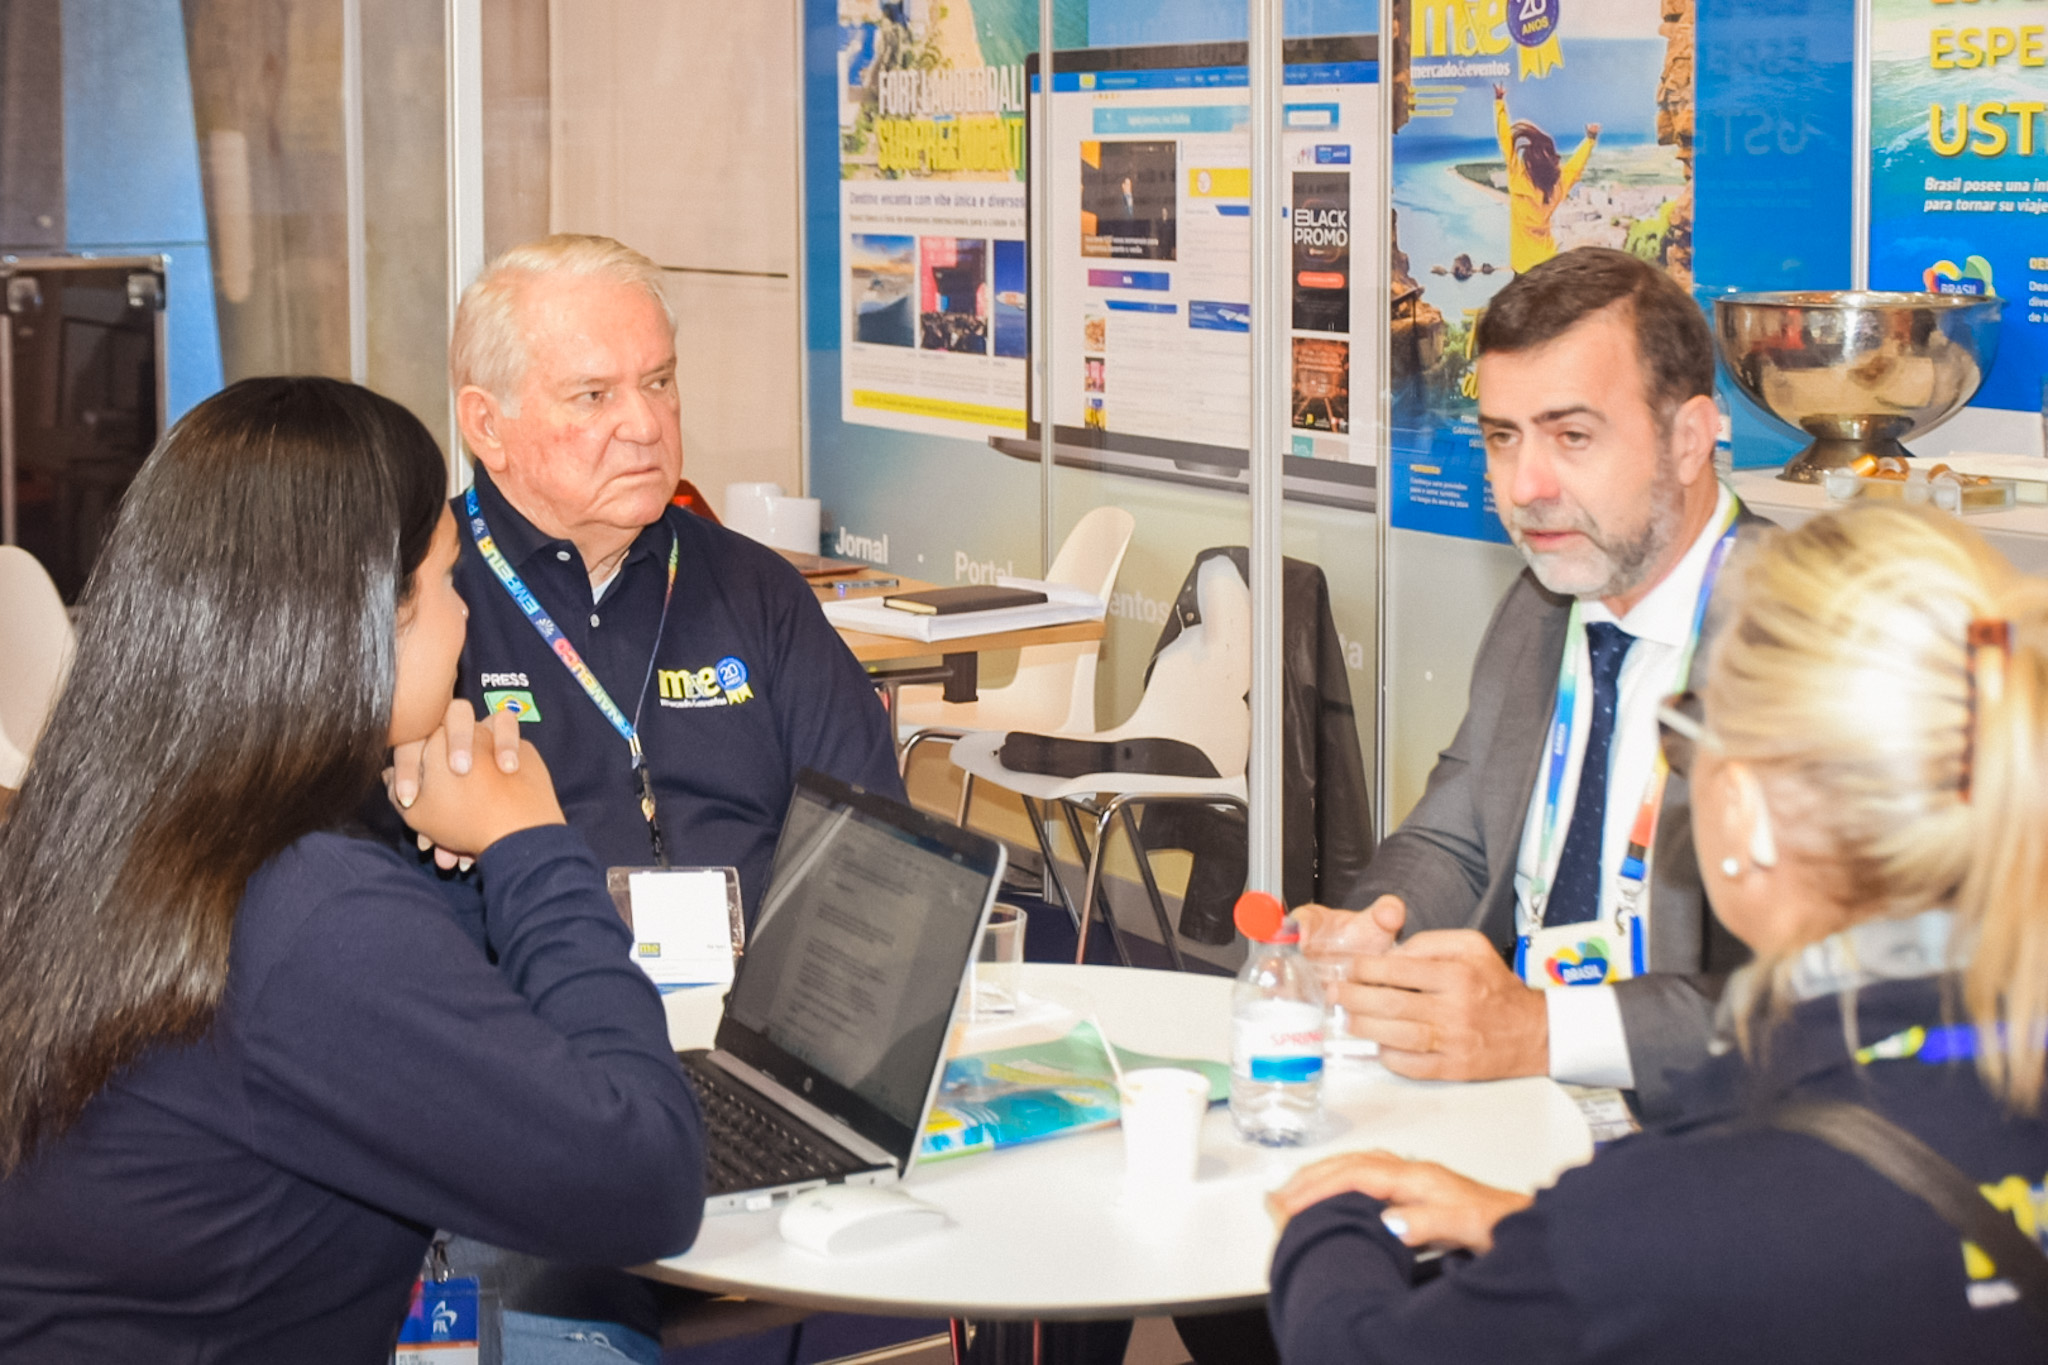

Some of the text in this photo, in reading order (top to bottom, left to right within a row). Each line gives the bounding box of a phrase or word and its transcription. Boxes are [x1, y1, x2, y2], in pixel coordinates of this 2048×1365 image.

[1522, 16, 1550, 35] ANOS
[879, 69, 919, 115] FORT
[1930, 102, 2048, 157] UST
[1924, 176, 2048, 194] Brasil posee una in
[1924, 198, 2048, 215] para tornar su viaje
[1294, 208, 1347, 227] BLACK
[1294, 228, 1348, 247] PROMO
[835, 526, 888, 564] Jornal
[477, 535, 541, 616] EMPETUR
[481, 672, 529, 687] PRESS
[720, 663, 739, 682] 20
[658, 666, 721, 699] m&e
[1562, 964, 1603, 982] BRASIL
